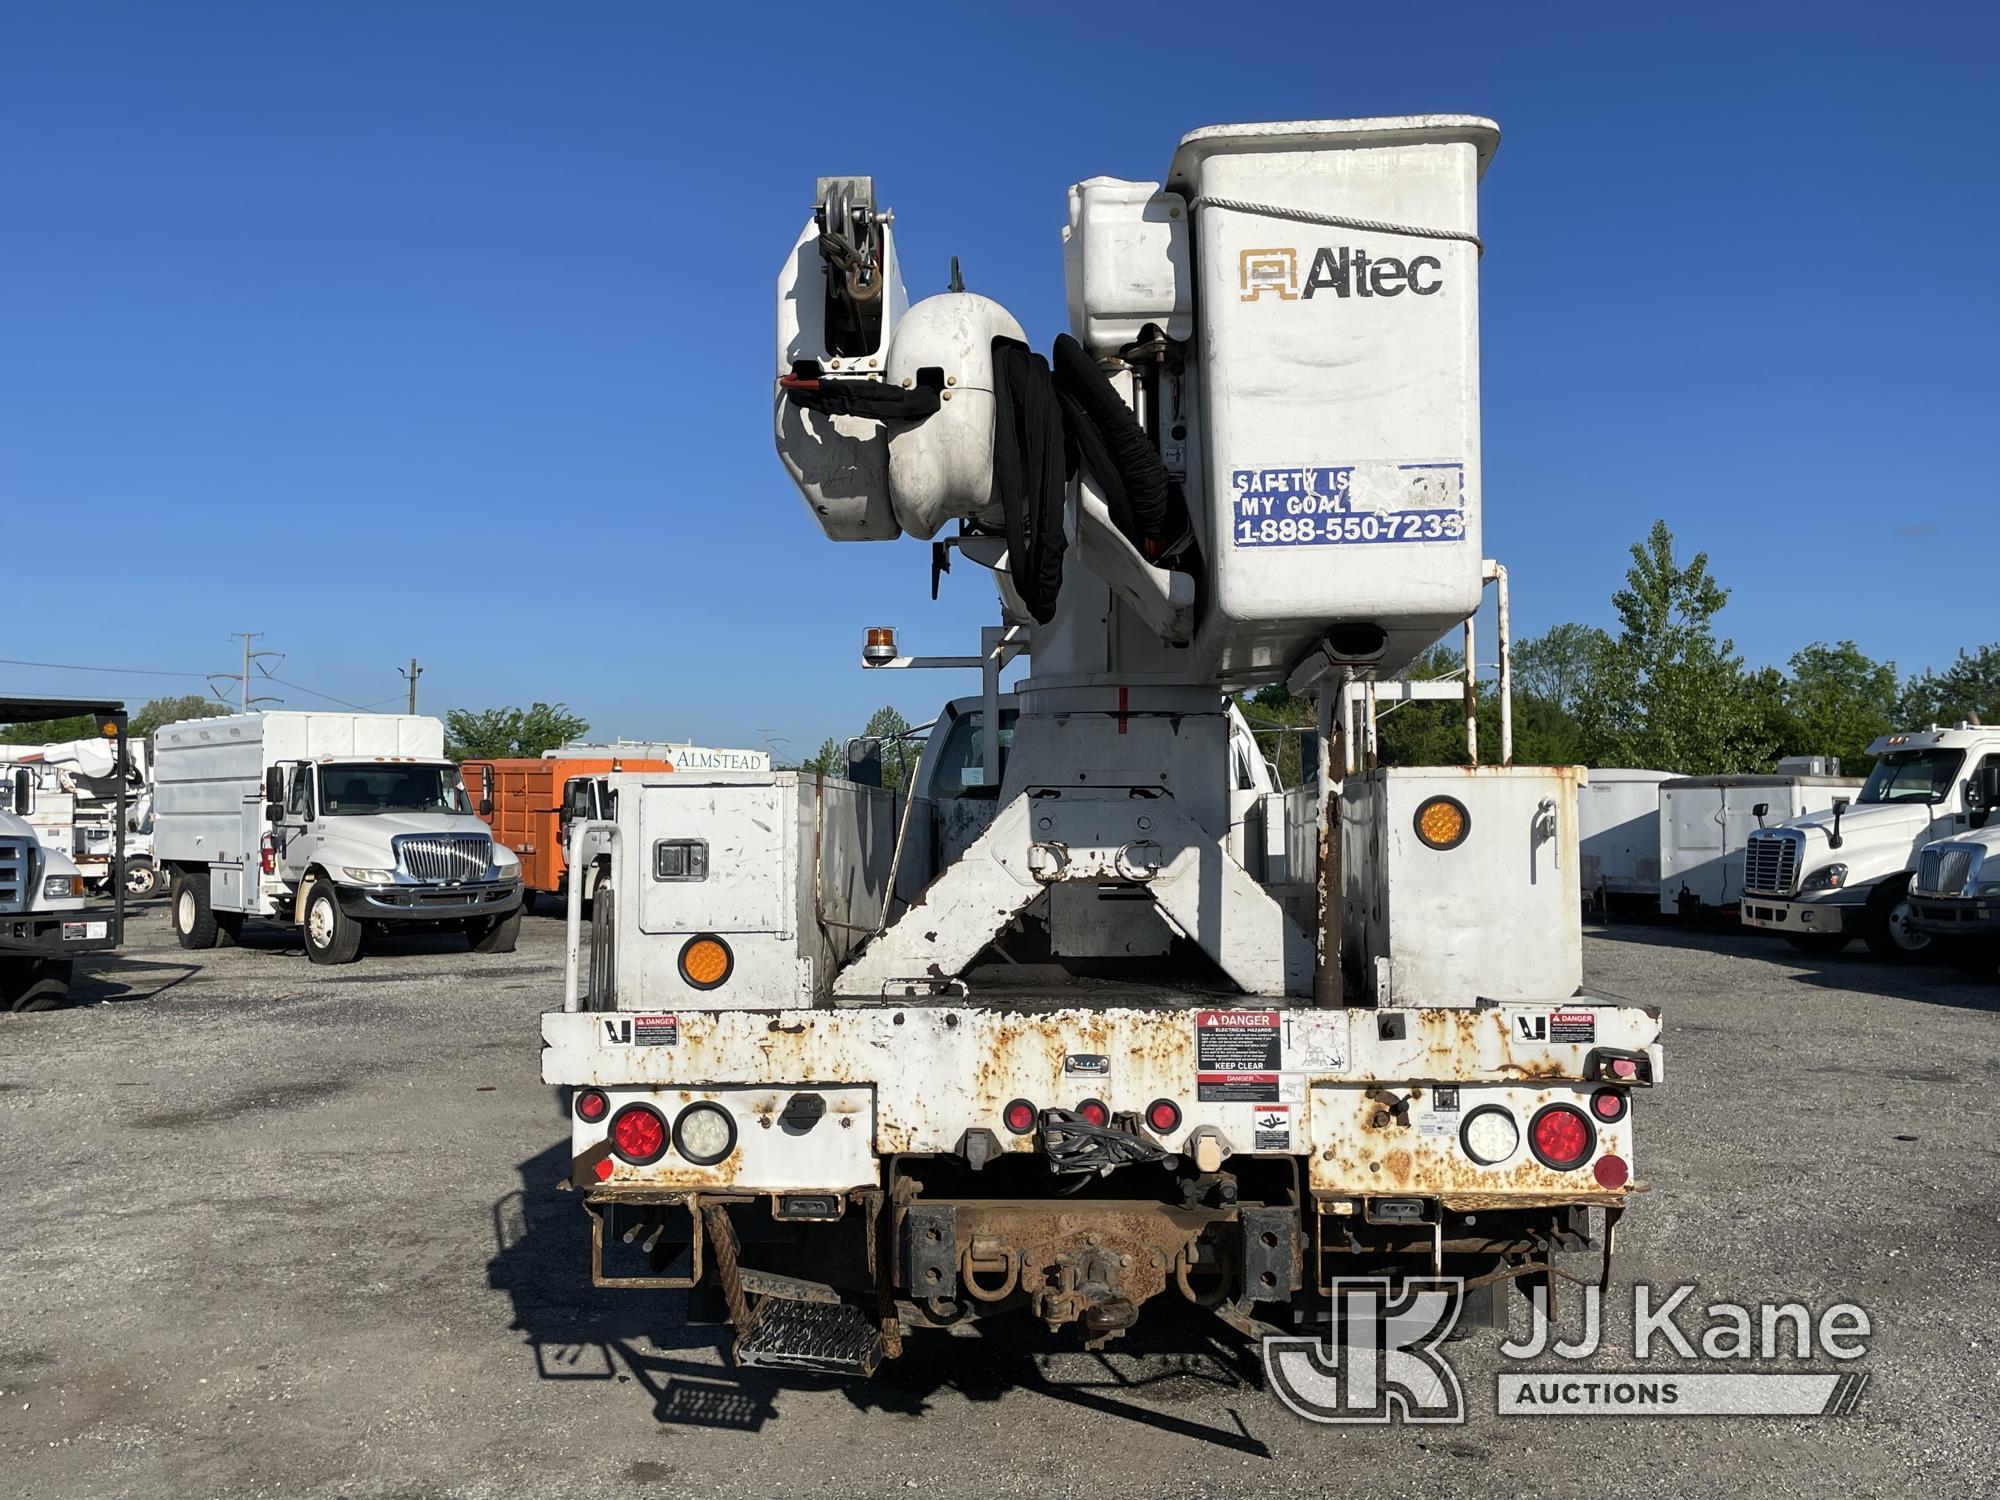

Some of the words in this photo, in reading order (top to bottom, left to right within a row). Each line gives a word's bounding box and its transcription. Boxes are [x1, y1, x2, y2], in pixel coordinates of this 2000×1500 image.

[1301, 246, 1443, 299] Altec
[1236, 469, 1317, 493] SAFETY
[1329, 471, 1351, 491] IS
[1242, 497, 1273, 516] MY
[1287, 495, 1346, 514] GOAL
[1237, 513, 1464, 543] 1-888-550-7233
[676, 750, 761, 770] ALMSTEAD
[1221, 1016, 1270, 1025] DANGER
[1215, 1062, 1236, 1070] KEEP
[1238, 1062, 1264, 1070] CLEAR
